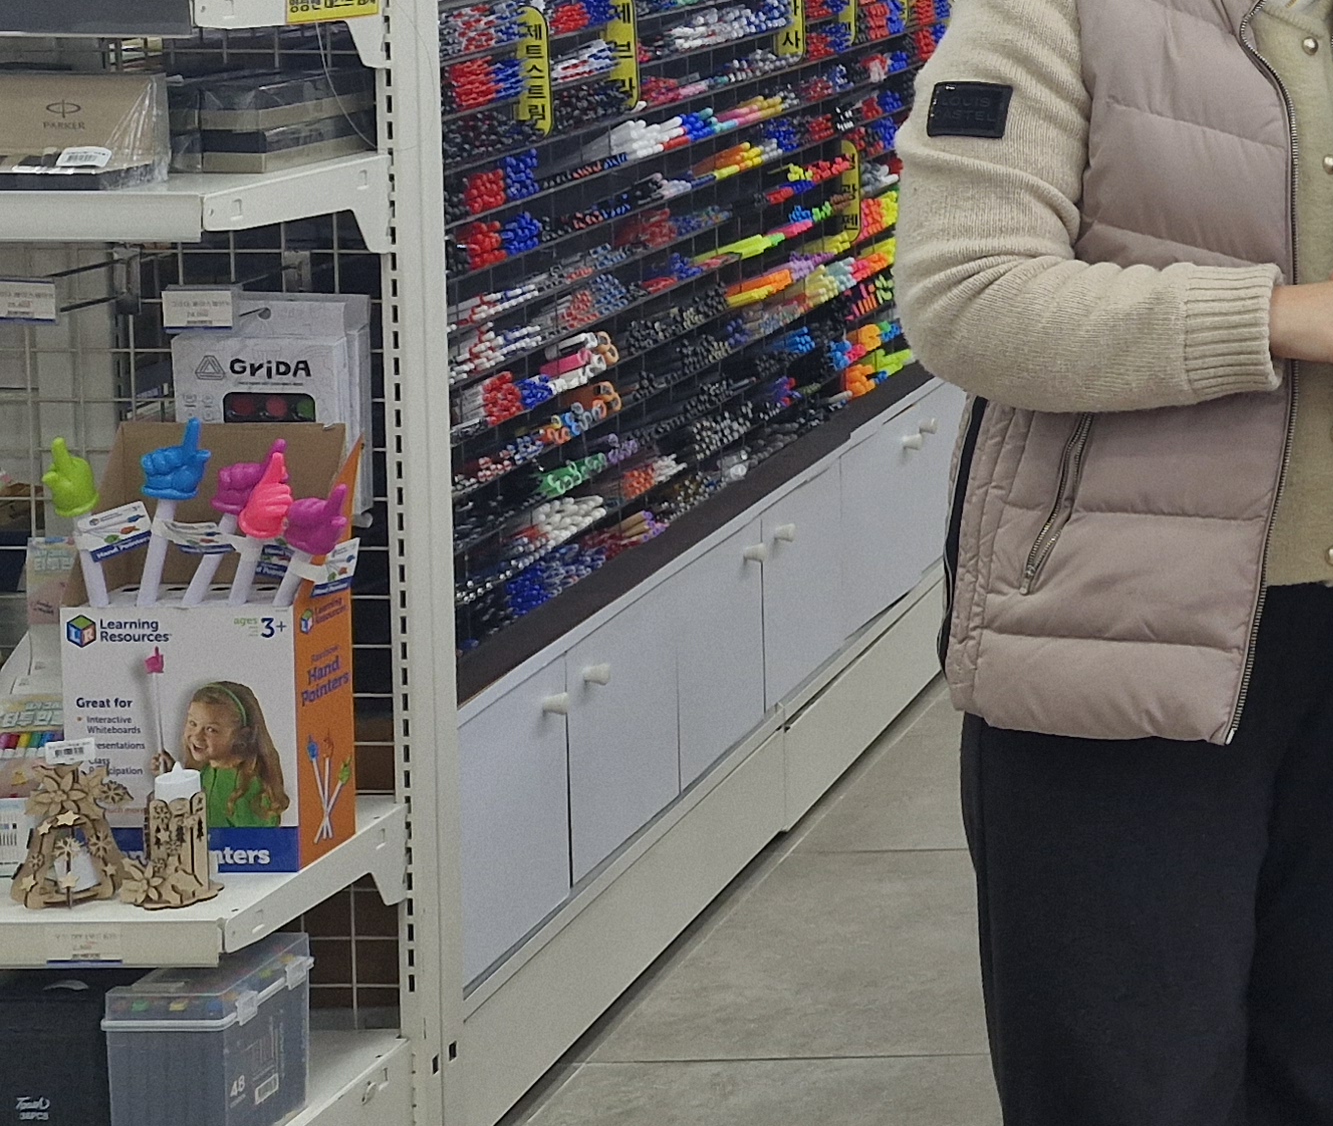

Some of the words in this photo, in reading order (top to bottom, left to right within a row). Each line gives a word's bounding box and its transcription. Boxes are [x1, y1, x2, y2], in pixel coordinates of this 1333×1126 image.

[525, 23, 547, 122] 제트스트림
[941, 96, 991, 108] LOUIS
[41, 120, 86, 131] PARKER
[228, 358, 312, 379] GriDA
[99, 618, 159, 632] Learning
[233, 617, 258, 626] ages
[260, 617, 287, 639] 3+
[99, 631, 170, 643] Resources
[307, 656, 340, 682] Hand
[301, 671, 350, 707] Pointers
[76, 697, 110, 709] Great
[113, 697, 133, 709] for
[86, 715, 132, 725] Interactive
[86, 725, 141, 735] Whiteboards
